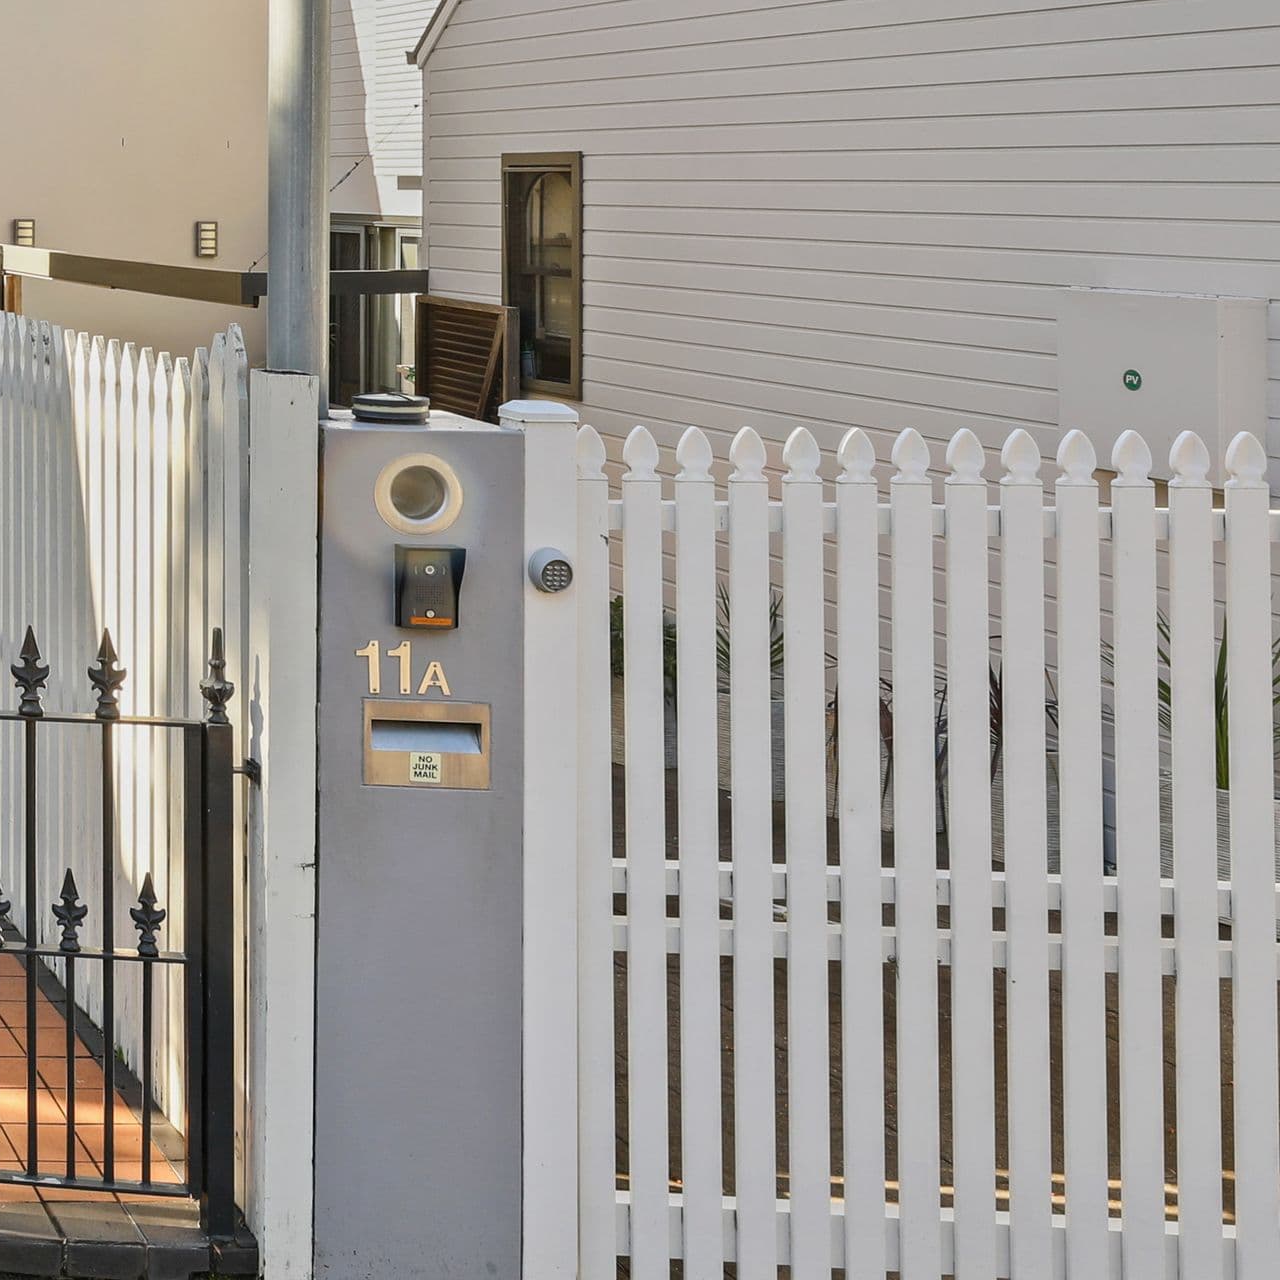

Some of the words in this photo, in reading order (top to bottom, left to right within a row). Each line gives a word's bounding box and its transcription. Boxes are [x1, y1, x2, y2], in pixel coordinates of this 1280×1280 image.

[1126, 375, 1139, 384] PV
[355, 640, 451, 696] 11A
[412, 763, 438, 771] JUNK
[413, 771, 437, 779] MAIL
